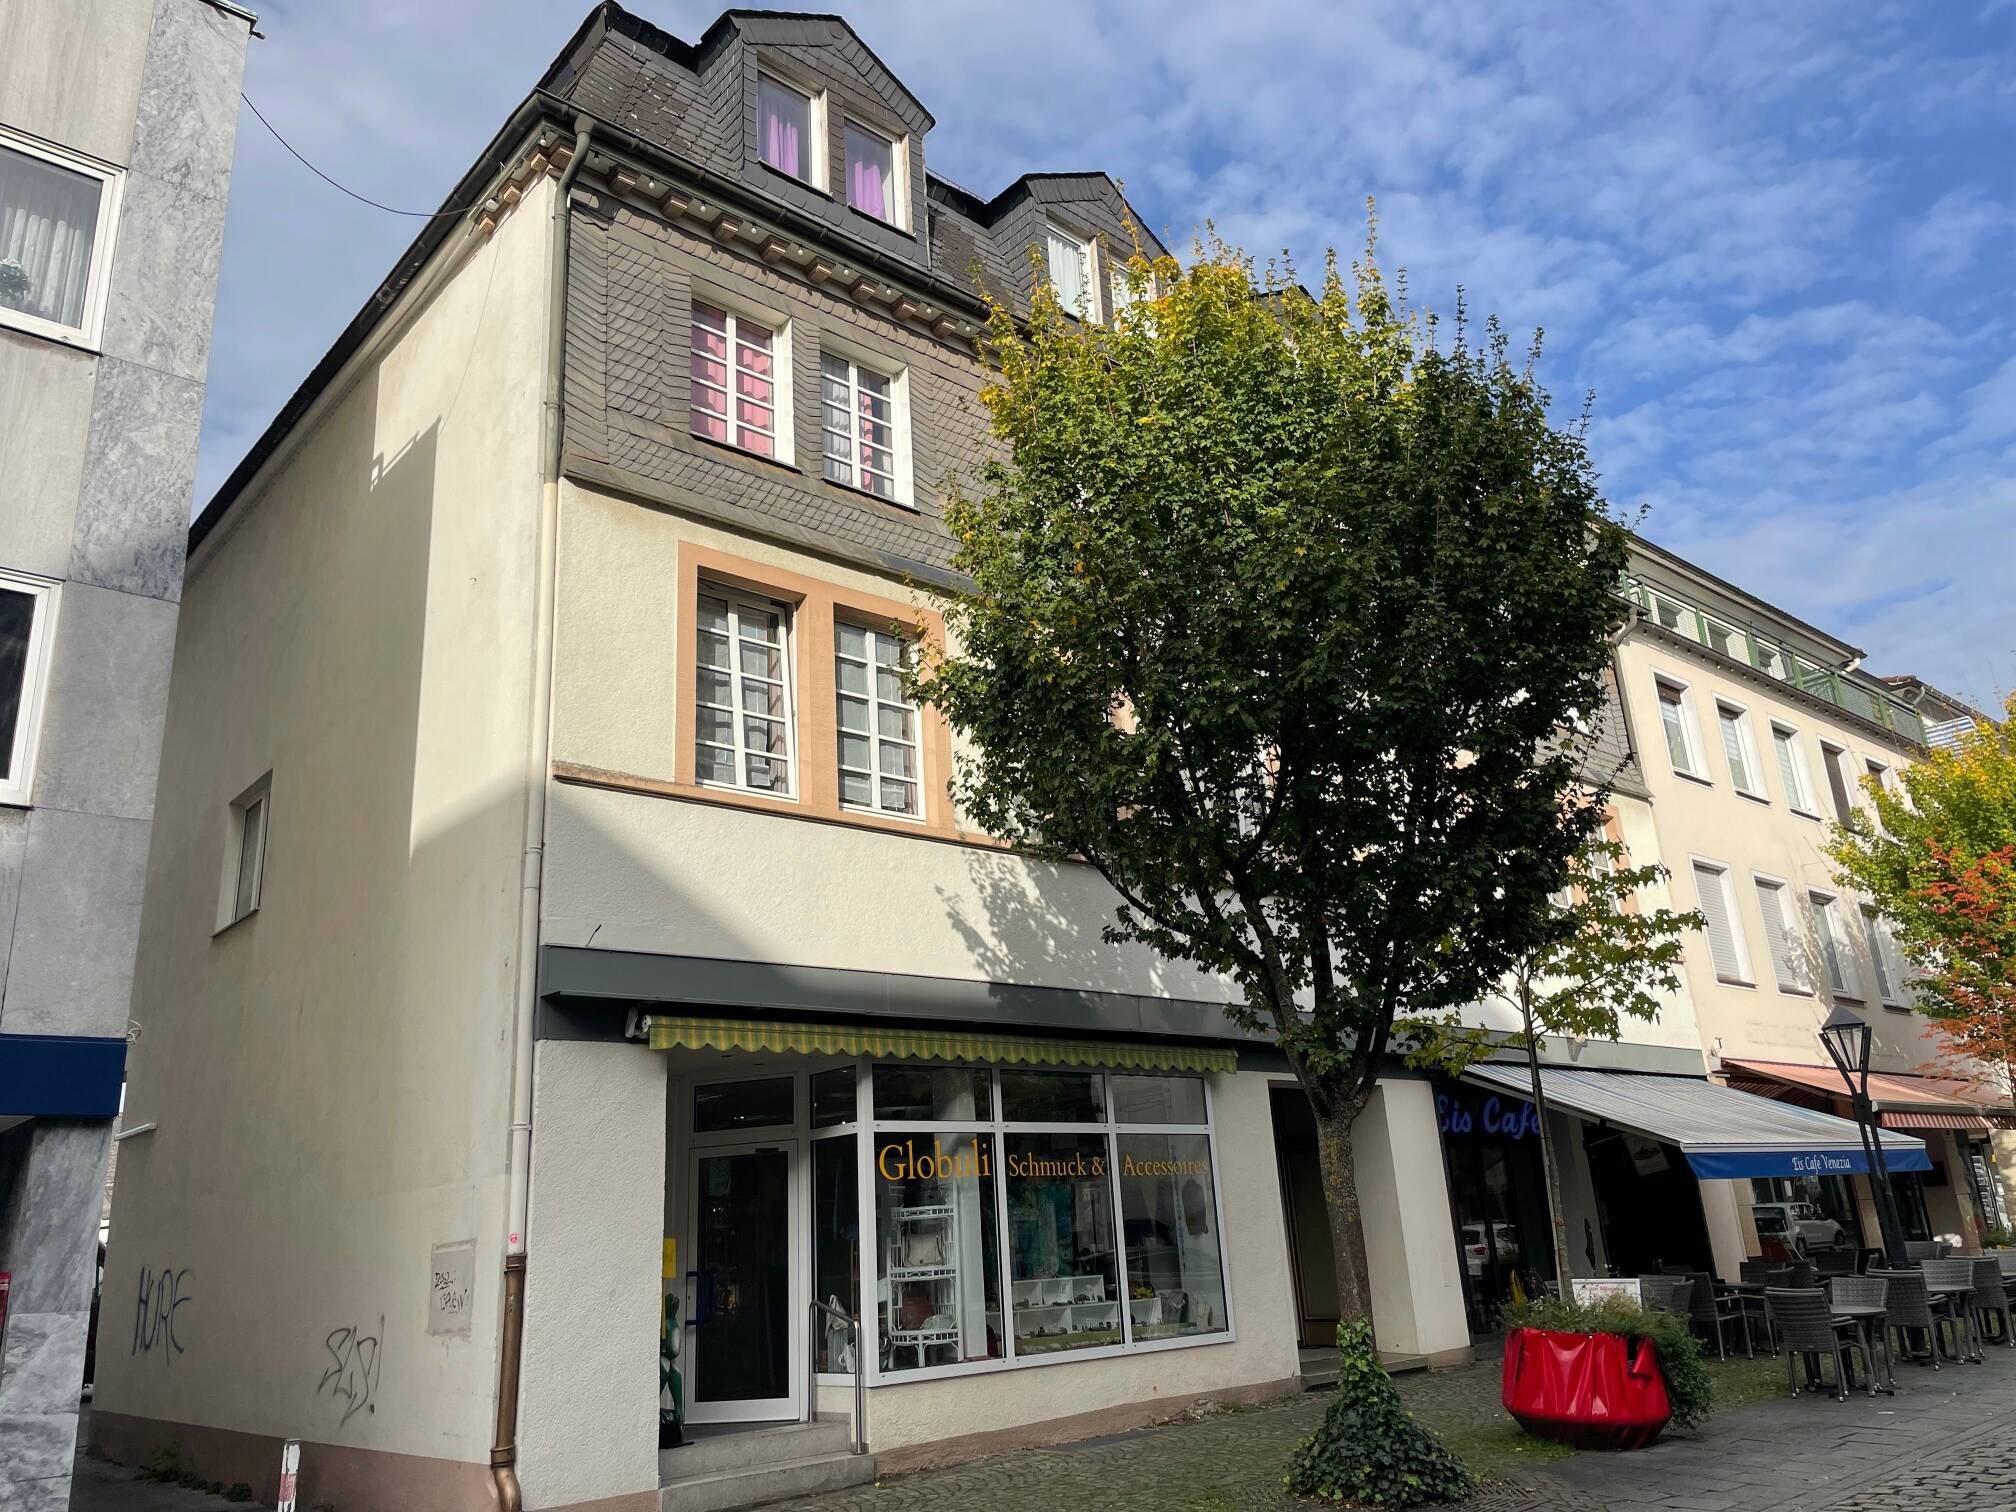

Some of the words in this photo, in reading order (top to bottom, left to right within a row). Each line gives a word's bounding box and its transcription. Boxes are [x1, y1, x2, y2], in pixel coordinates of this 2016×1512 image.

[1437, 1094, 1472, 1133] Eis
[879, 1137, 992, 1181] Globuli
[1008, 1152, 1088, 1177] Schmuck
[1092, 1155, 1105, 1177] &
[1123, 1154, 1209, 1177] Accessoires
[1791, 1156, 1804, 1171] Eis
[1805, 1154, 1821, 1175] Cafe
[1820, 1154, 1852, 1169] Venezia
